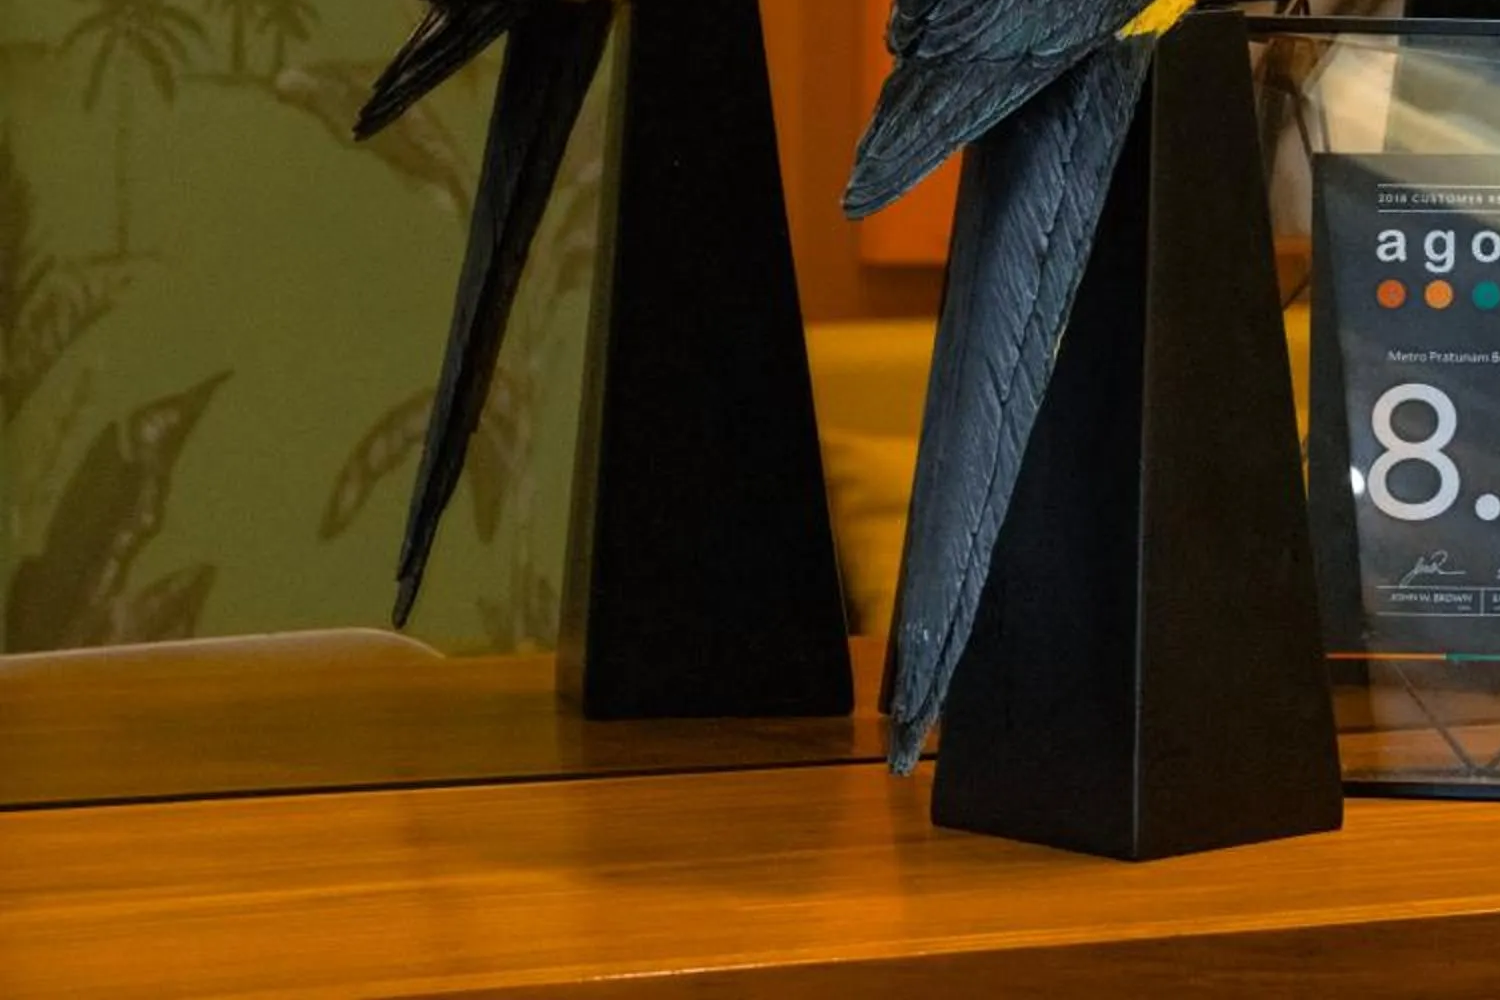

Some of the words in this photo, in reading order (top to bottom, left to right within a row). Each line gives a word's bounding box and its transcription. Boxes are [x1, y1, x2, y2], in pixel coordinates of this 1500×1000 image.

[1411, 193, 1483, 205] CUSTOMER
[1387, 350, 1428, 363] Metro
[1429, 351, 1489, 363] Pratunam
[1433, 592, 1474, 604] BROWN
